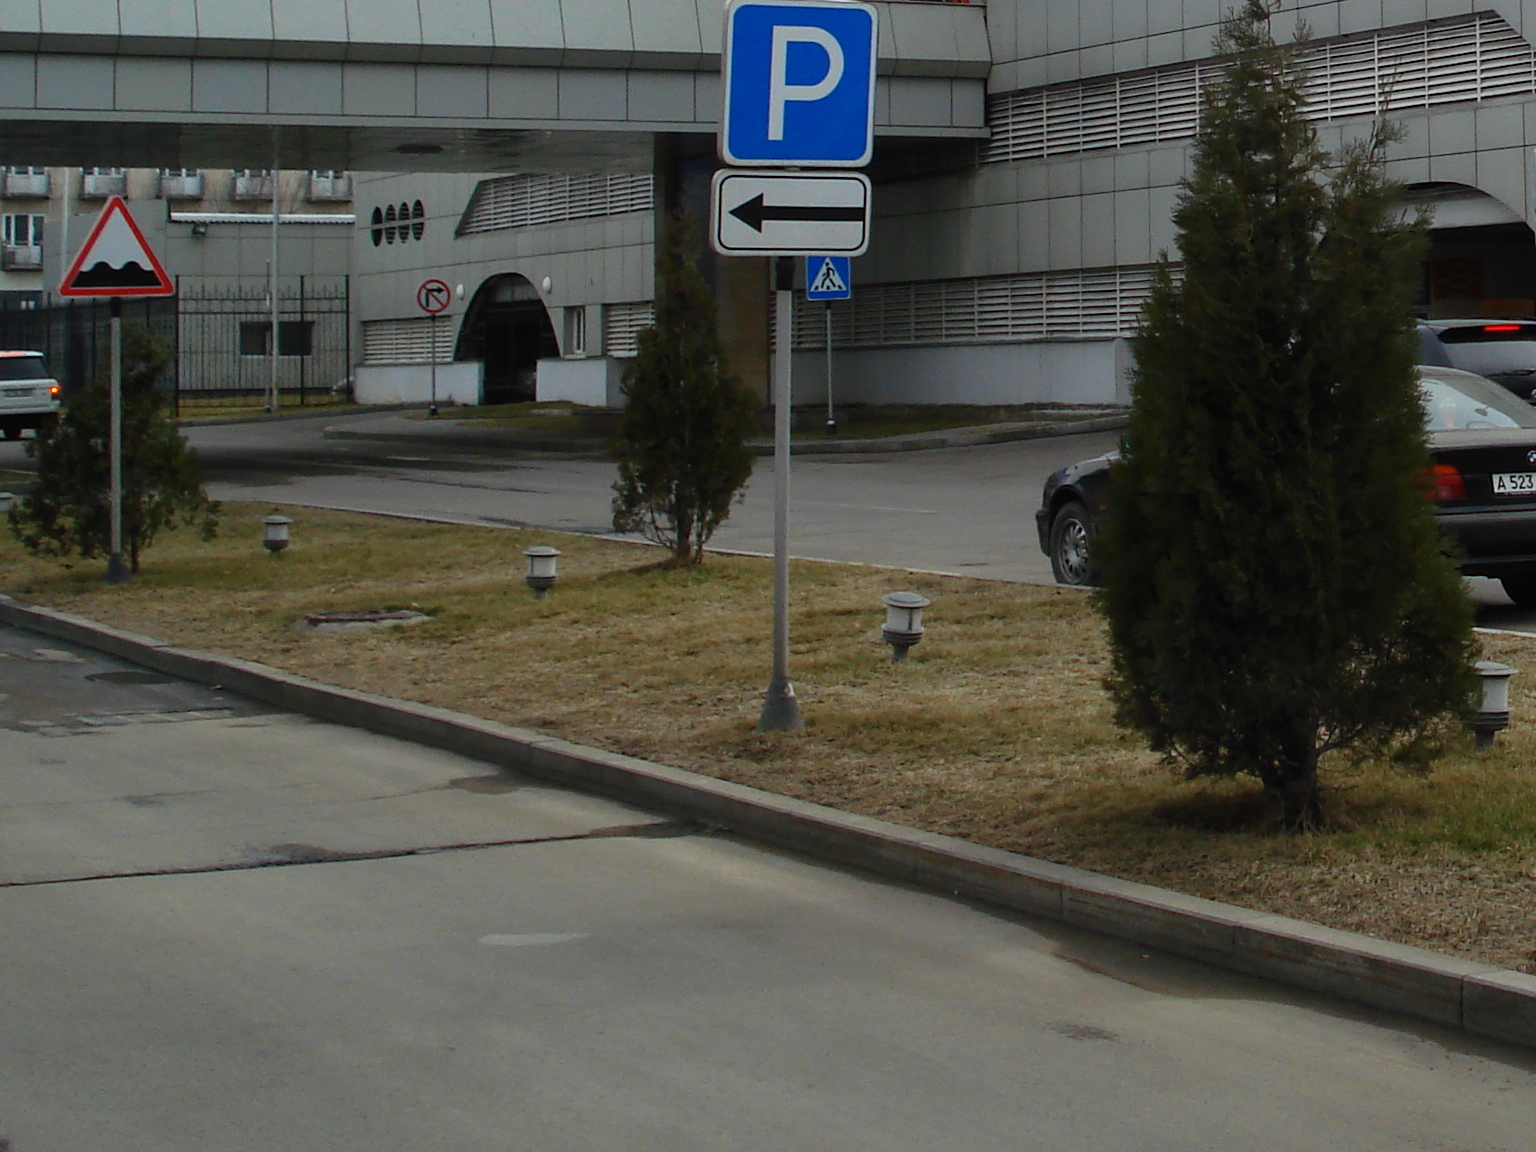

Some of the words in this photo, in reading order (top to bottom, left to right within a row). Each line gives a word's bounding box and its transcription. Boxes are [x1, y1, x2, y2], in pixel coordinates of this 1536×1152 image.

[767, 25, 845, 141] P
[1497, 475, 1507, 490] A
[1509, 473, 1534, 490] 523
